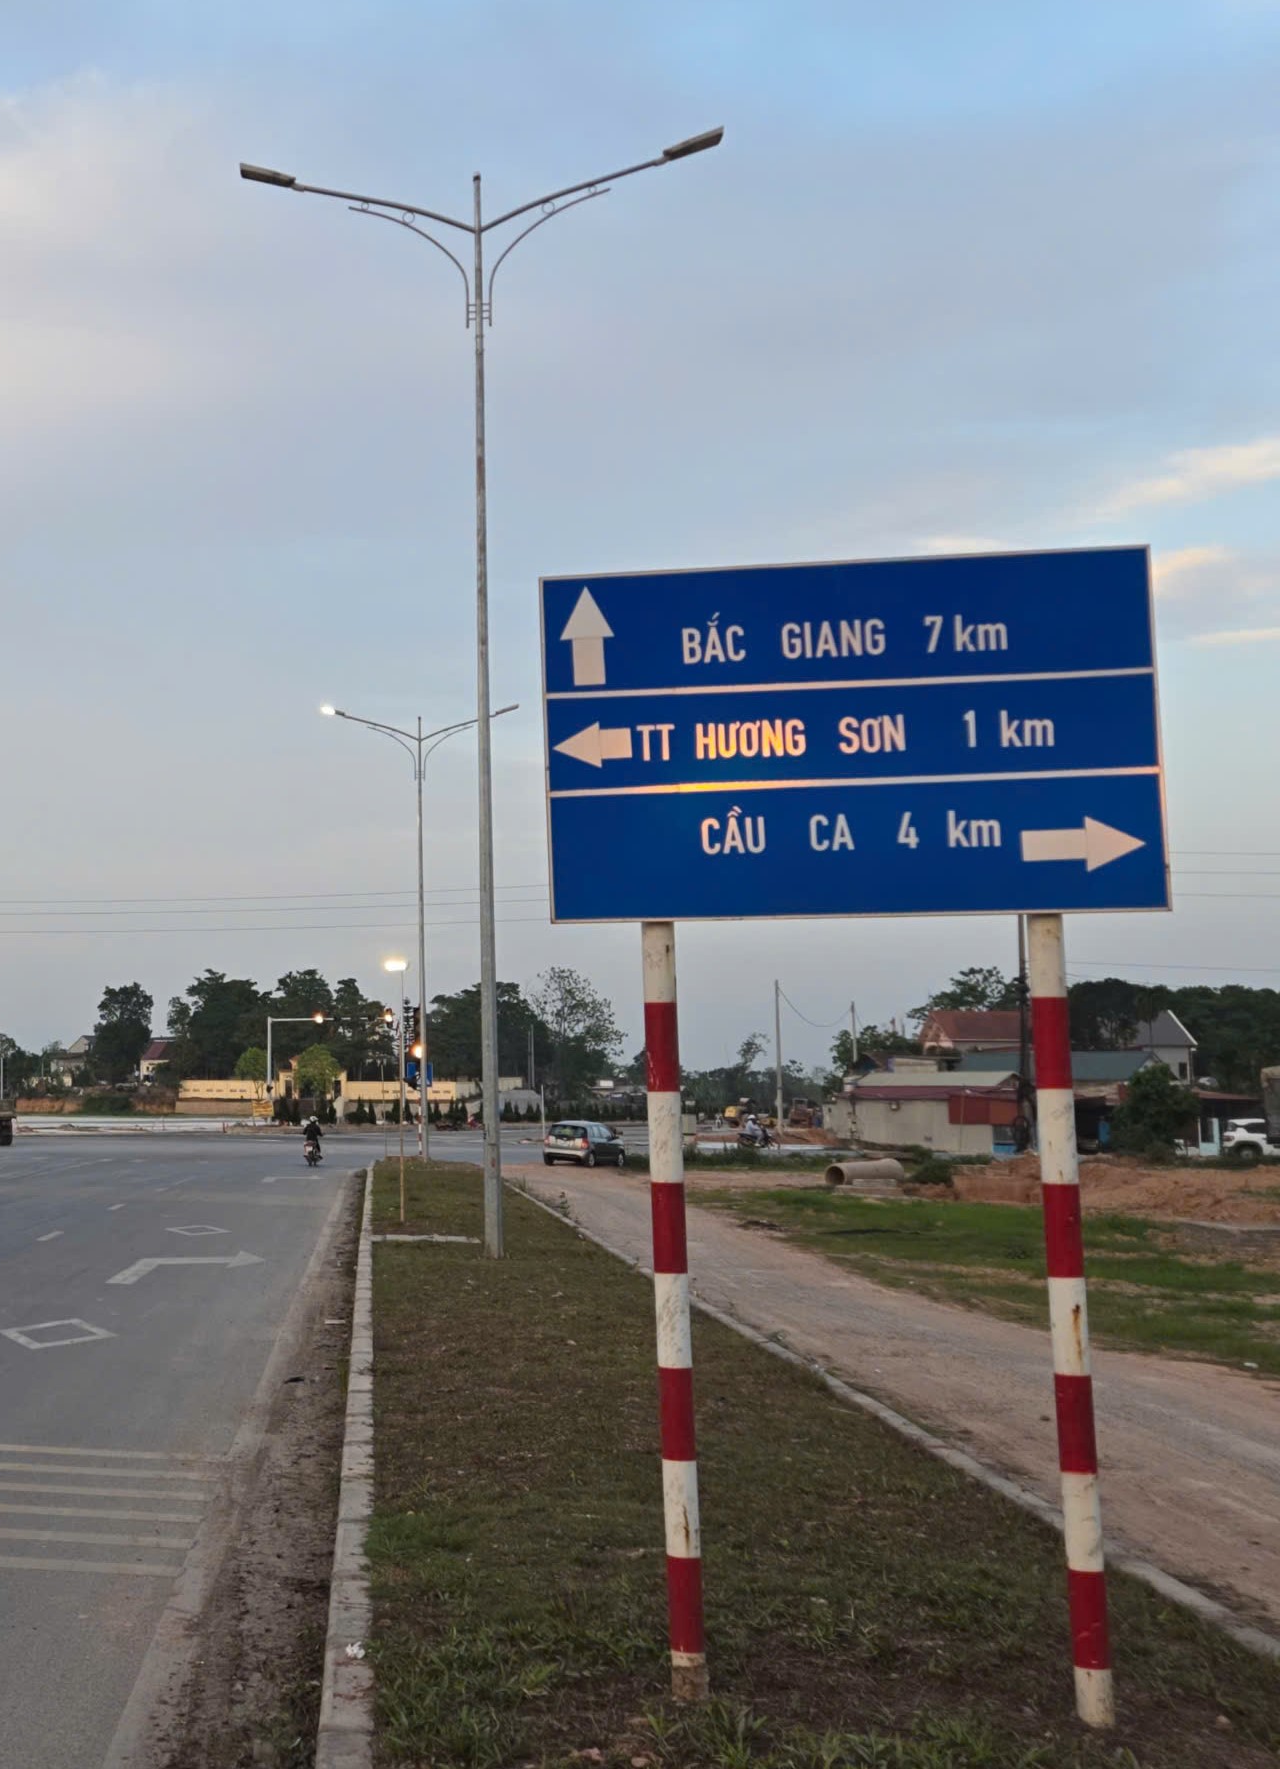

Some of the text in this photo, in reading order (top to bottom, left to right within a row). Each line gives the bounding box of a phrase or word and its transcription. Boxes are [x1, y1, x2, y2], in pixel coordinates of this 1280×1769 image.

[681, 611, 1008, 664] BẮC GIANG 7 km
[636, 710, 1055, 761] TT HƯƠNG SƠN 1 km
[701, 805, 1001, 855] CẦU CA 4 km
